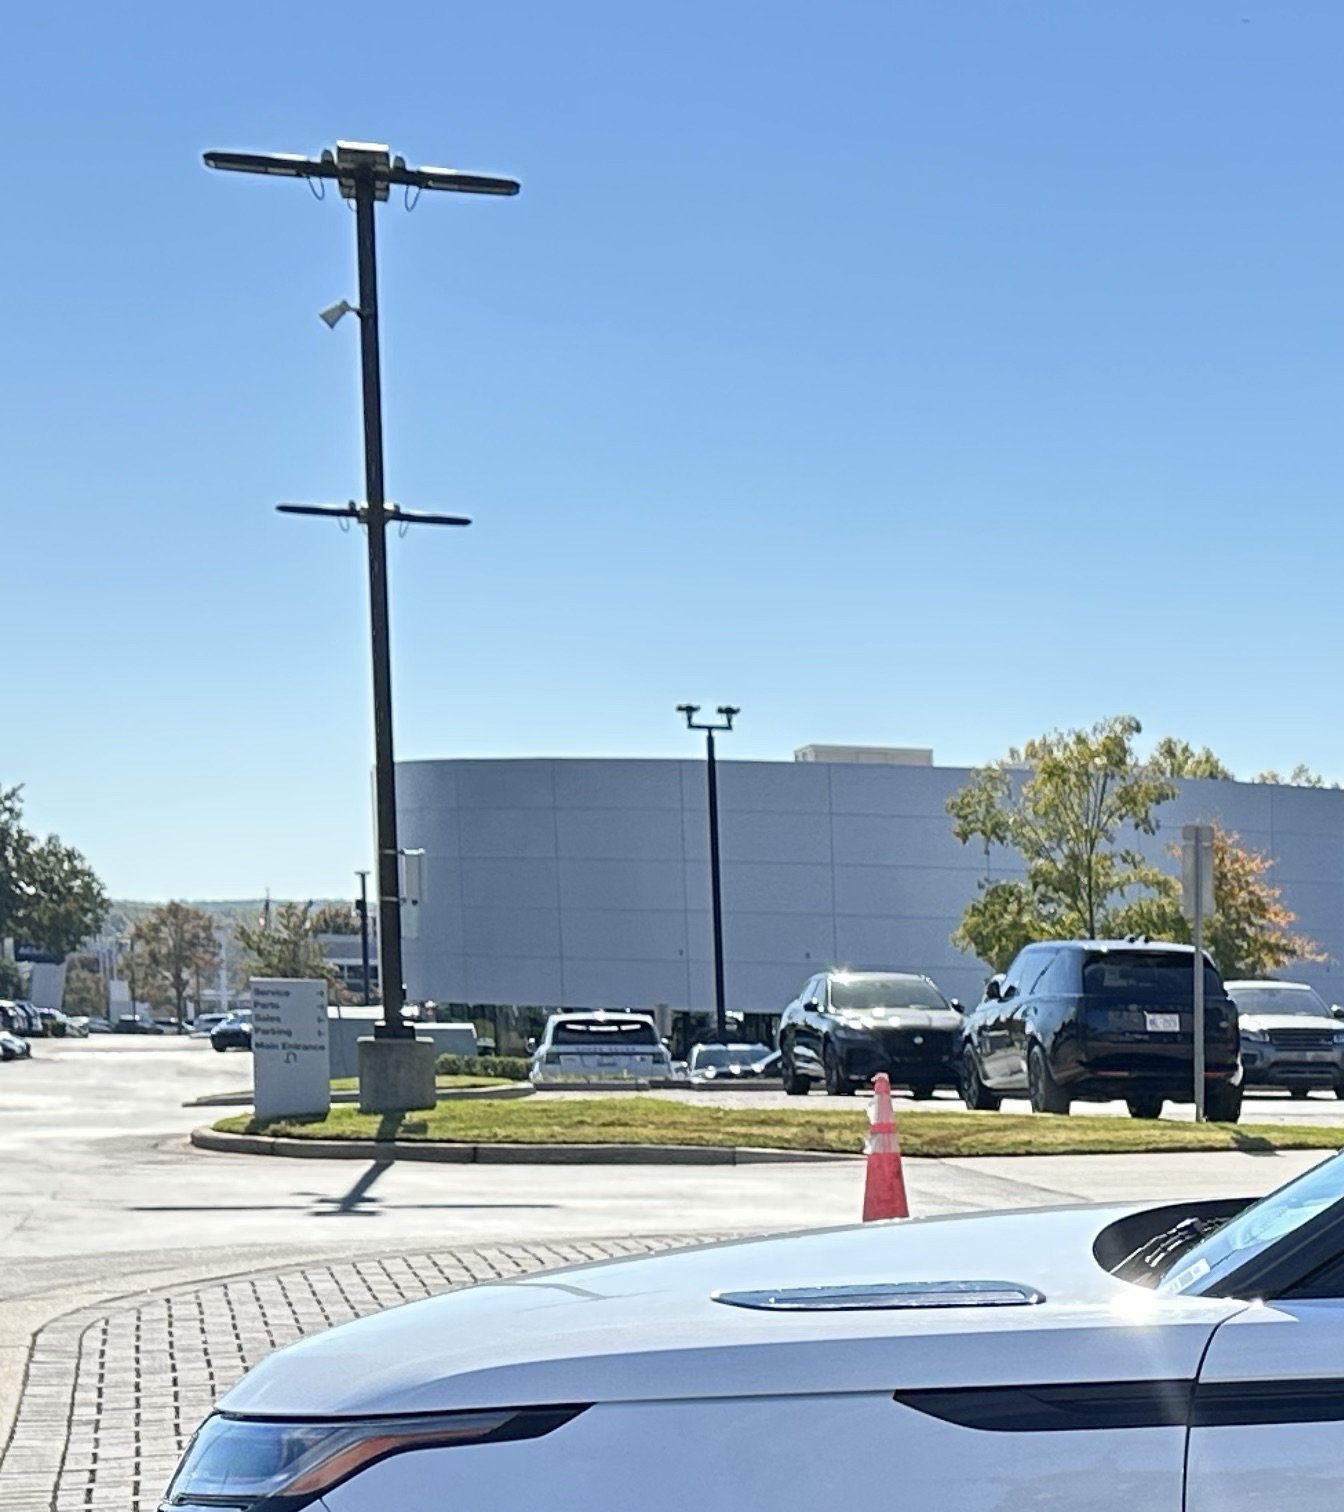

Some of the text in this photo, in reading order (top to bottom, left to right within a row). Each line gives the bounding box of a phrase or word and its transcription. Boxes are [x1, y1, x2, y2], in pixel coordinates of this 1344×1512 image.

[254, 987, 291, 998] Service
[253, 1000, 280, 1009] Parts
[255, 1013, 281, 1023] Sales
[254, 1027, 293, 1038] Parking
[254, 1041, 326, 1052] Main Entrance
